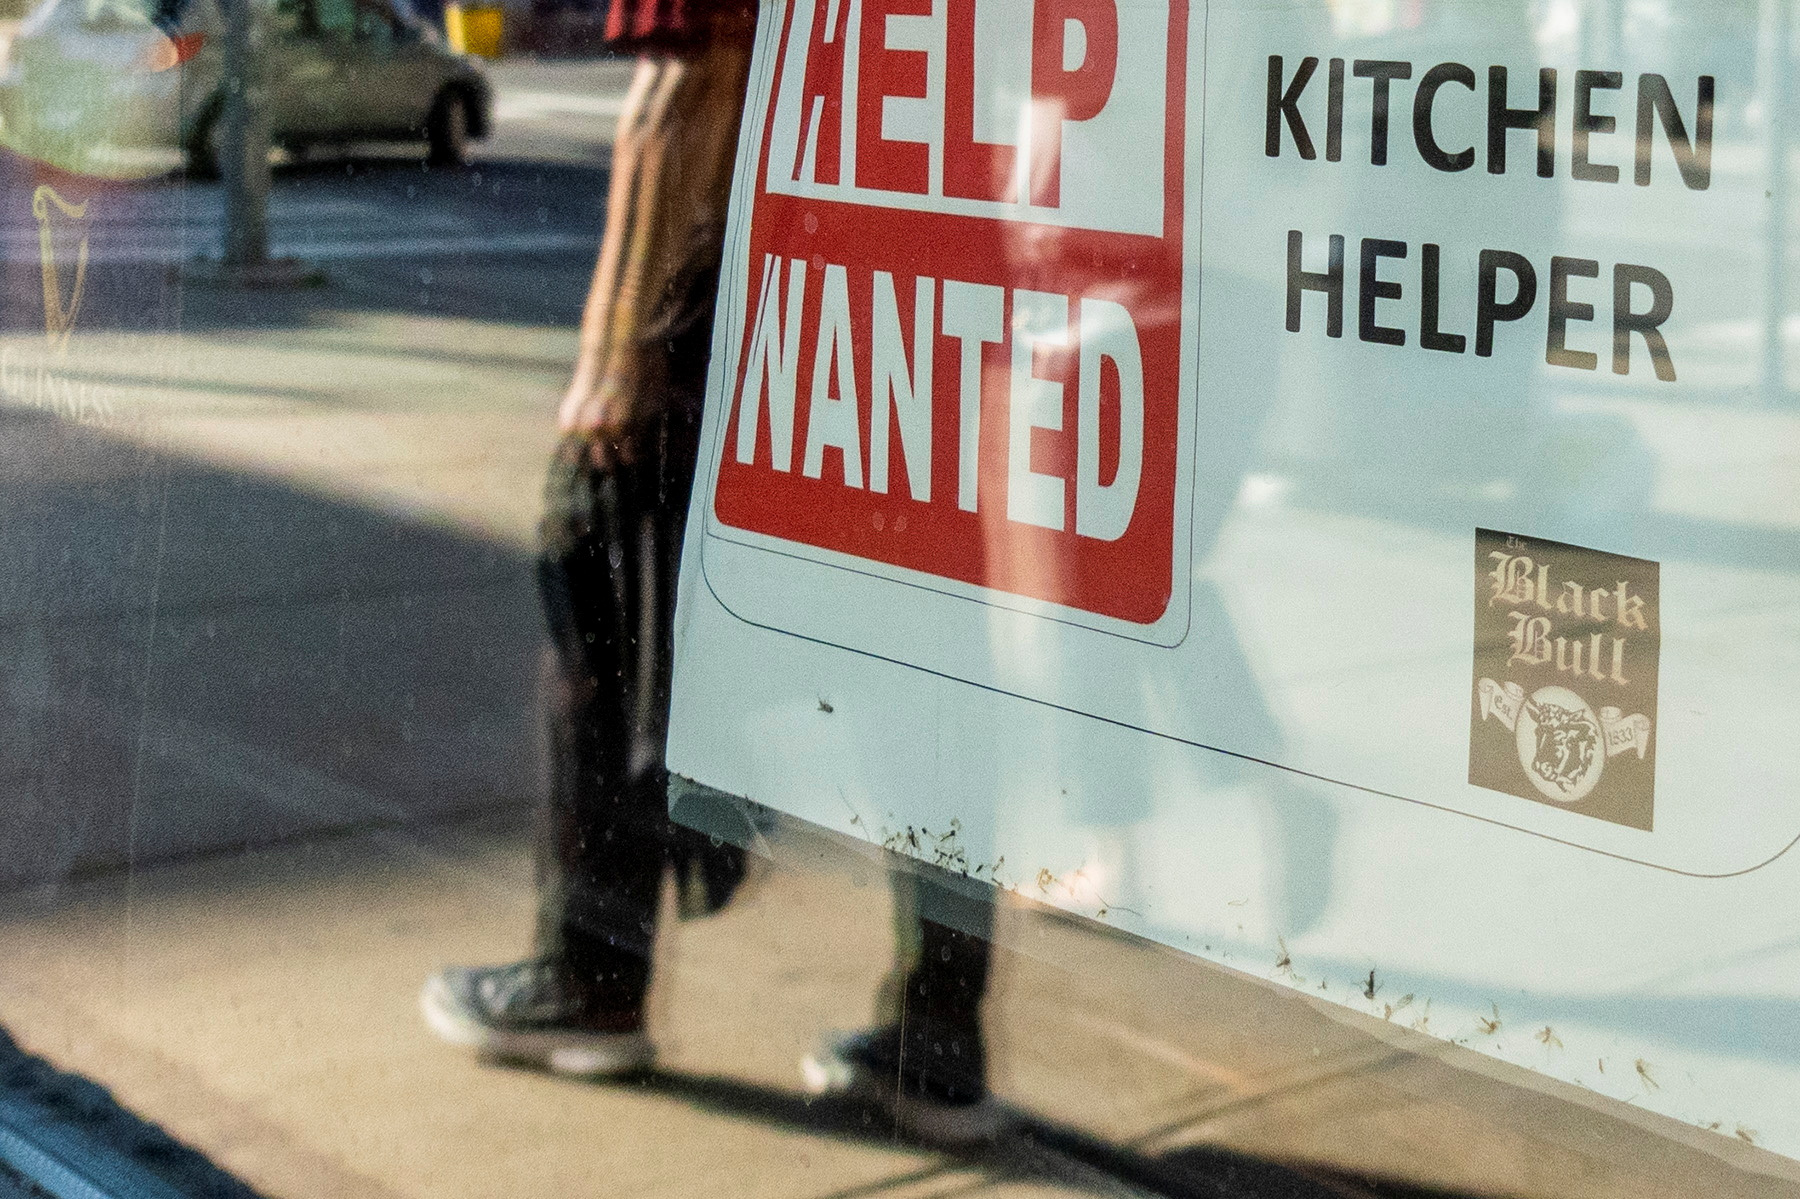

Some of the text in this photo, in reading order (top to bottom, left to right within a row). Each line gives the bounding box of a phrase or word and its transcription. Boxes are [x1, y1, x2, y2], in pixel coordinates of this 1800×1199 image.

[1265, 55, 1715, 191] KITCHEN
[1285, 230, 1677, 382] HELPER
[735, 252, 1144, 543] WANTED
[1488, 551, 1647, 630] Black
[1507, 611, 1630, 685] Bull
